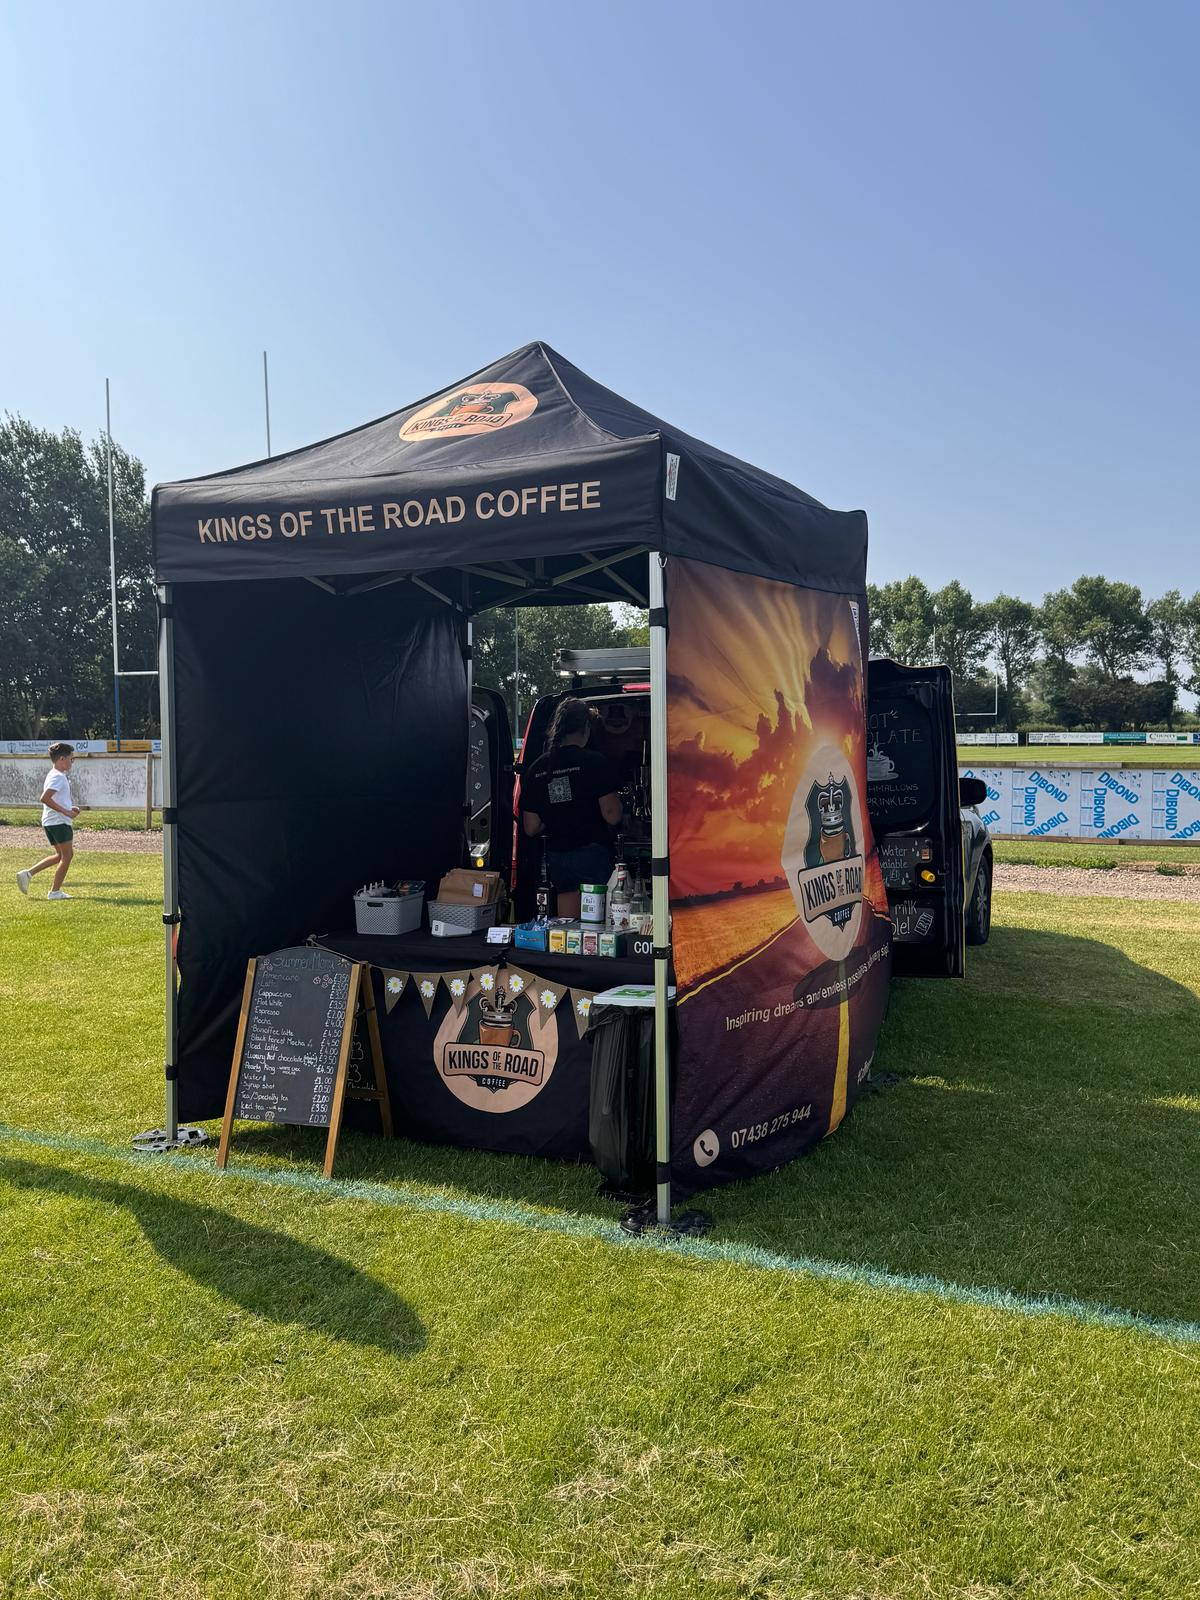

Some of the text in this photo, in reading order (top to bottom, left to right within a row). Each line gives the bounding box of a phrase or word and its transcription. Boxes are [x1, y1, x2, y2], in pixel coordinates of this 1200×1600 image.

[463, 414, 504, 423] ROAD
[198, 480, 601, 543] KINGS OF THE ROAD COFFEE
[867, 713, 890, 729] OT
[1028, 770, 1068, 802] DIBOND
[1098, 771, 1139, 804] DIBOND
[1024, 787, 1038, 826] DIBOND
[1093, 788, 1107, 828] DIBOND
[1166, 789, 1180, 830] DIBOND
[881, 845, 907, 857] Water
[803, 871, 836, 911] KINGS
[895, 900, 917, 915] milk
[834, 908, 850, 922] COFFEE
[262, 970, 299, 981] Americano
[258, 988, 292, 1000] Cappuccino
[254, 1006, 280, 1016] Espresso
[725, 1008, 771, 1031] Inspiring
[806, 986, 821, 1005] and
[253, 1016, 271, 1025] Mocha
[250, 1033, 266, 1041] Black
[287, 1037, 305, 1046] Mocha
[322, 1029, 342, 1038] £4.50
[247, 1051, 265, 1064] Luxury
[277, 1053, 303, 1063] chocolate
[448, 1050, 539, 1077] KINGS OF ROAD
[316, 1064, 334, 1075] £4.50
[492, 1062, 502, 1071] THE
[243, 1073, 262, 1081] Water
[481, 1077, 506, 1088] COFFEE
[242, 1081, 260, 1090] Syrup
[313, 1085, 331, 1094] £0.50
[312, 1094, 329, 1103] £2.00
[240, 1102, 253, 1110] Iced
[255, 1103, 265, 1111] tea
[310, 1103, 328, 1113] £3.50
[731, 1103, 812, 1149] 07438 275 944
